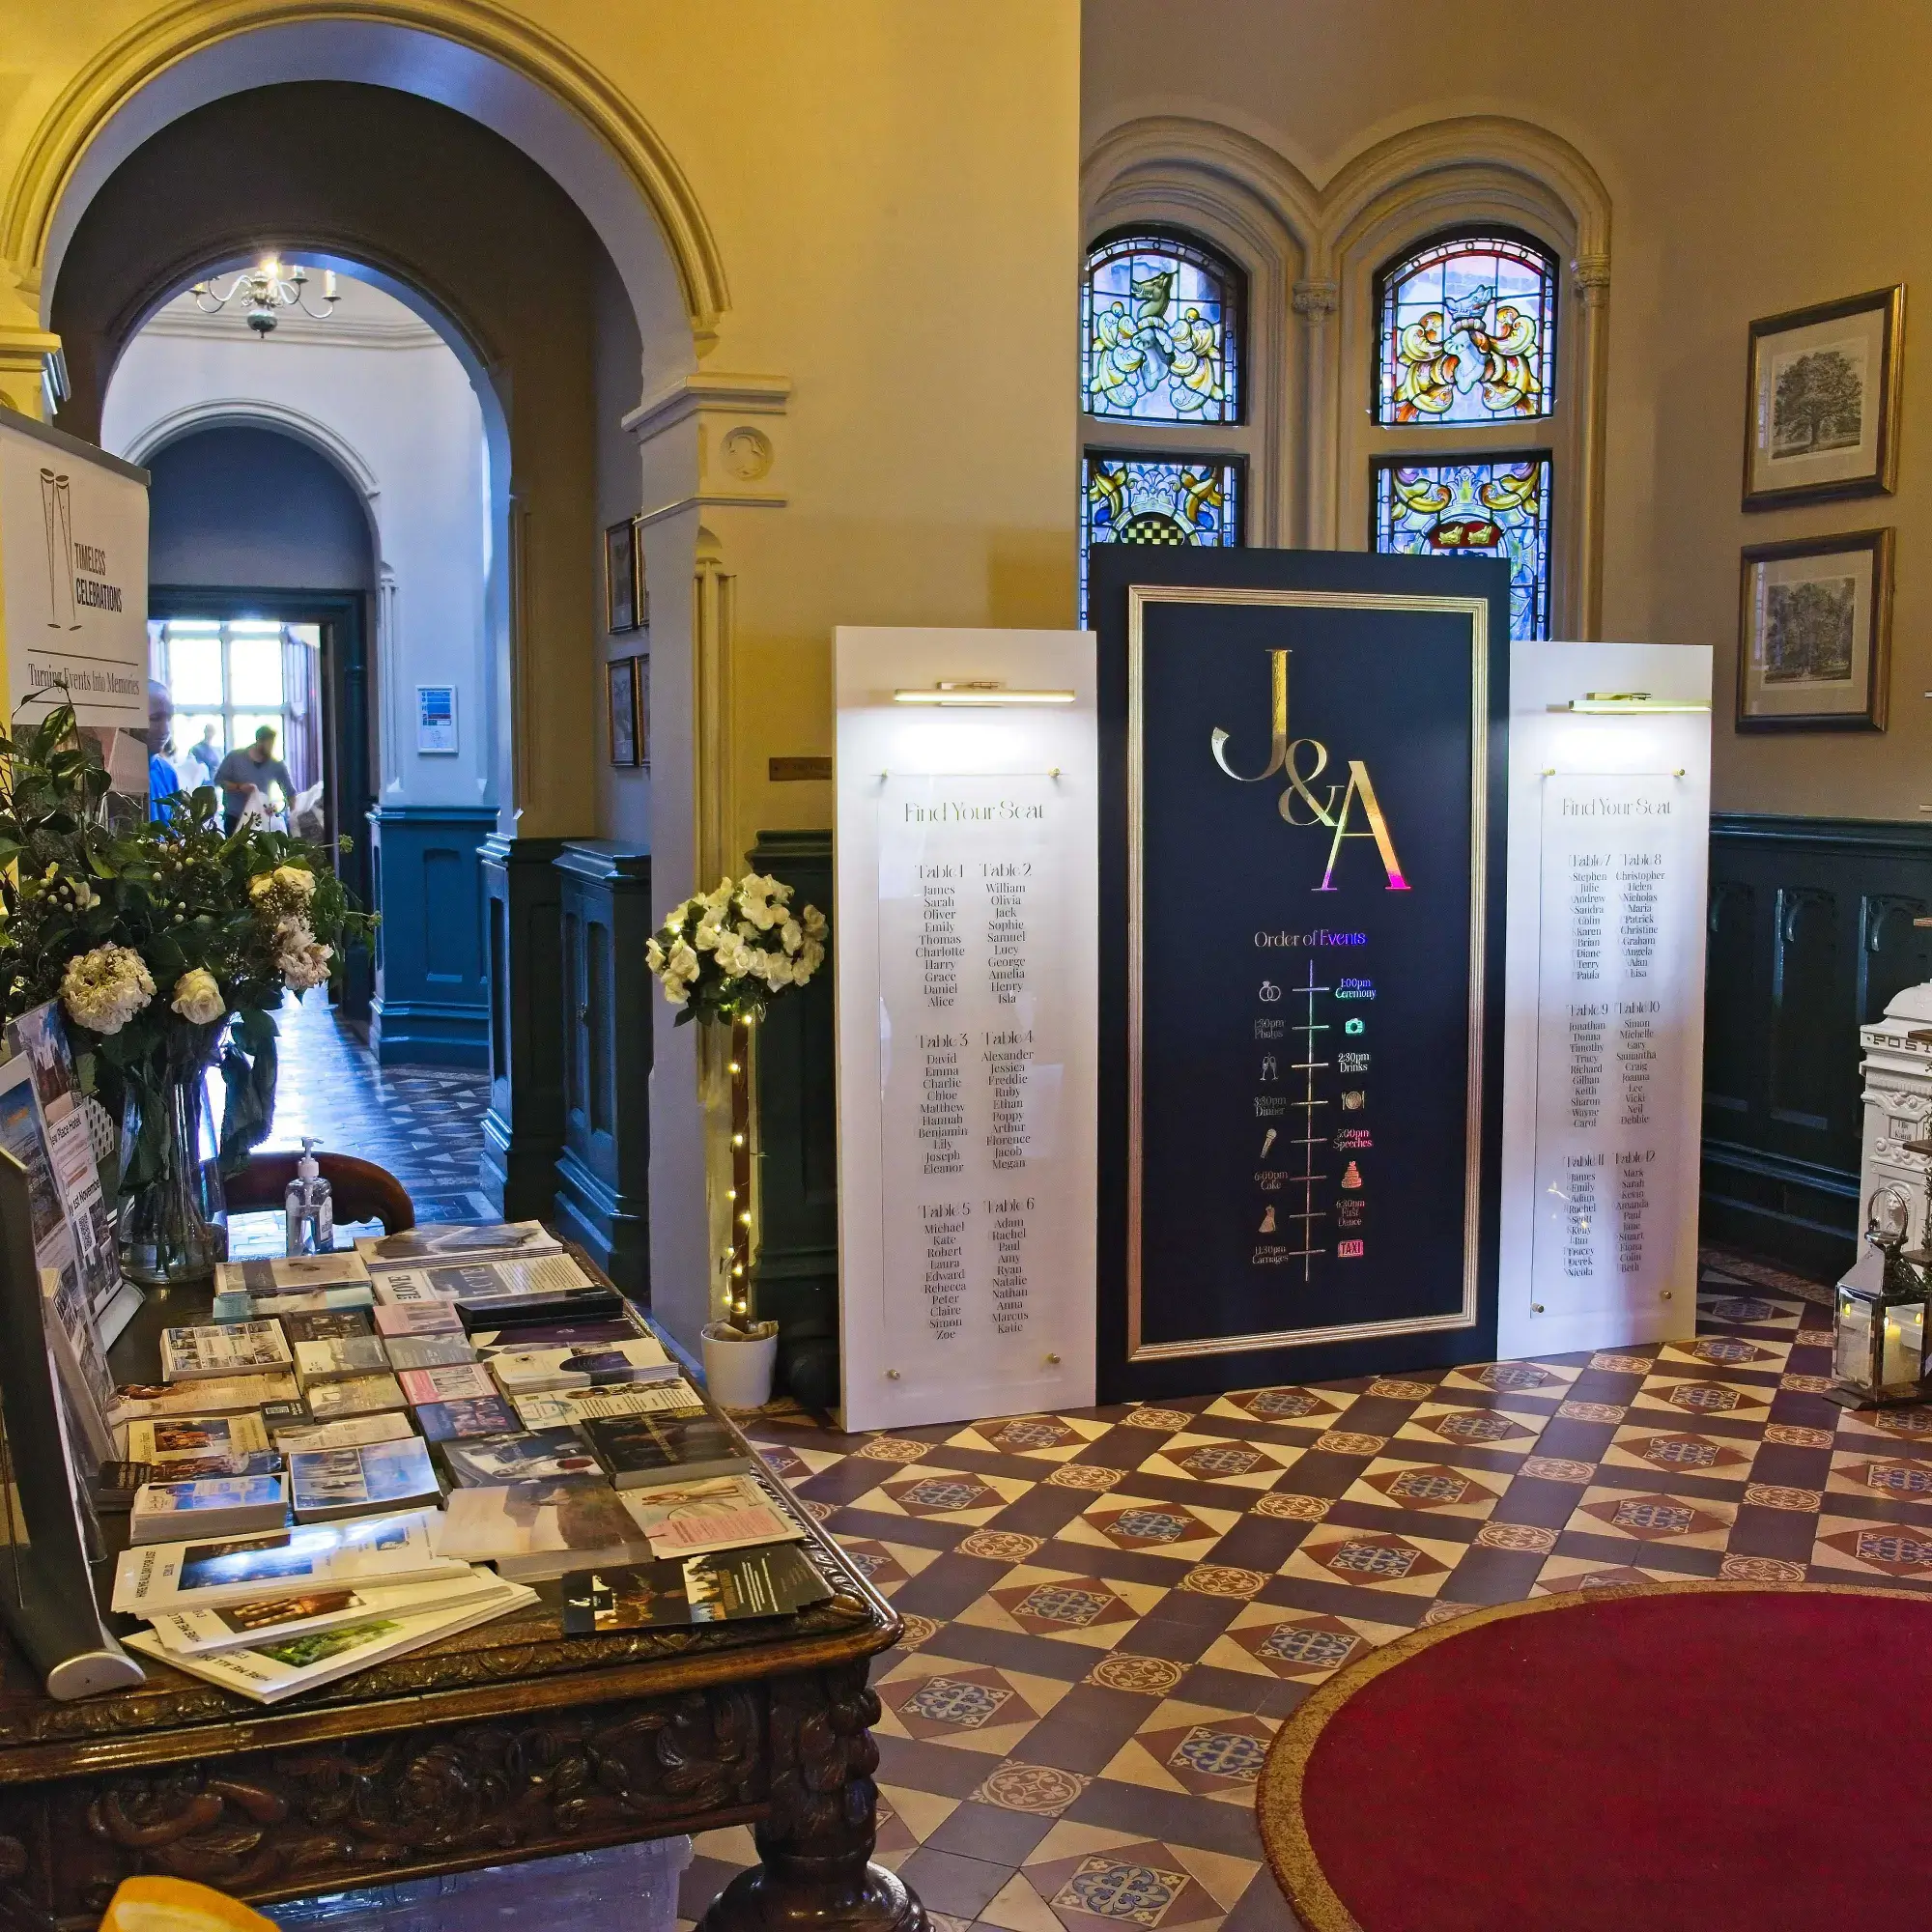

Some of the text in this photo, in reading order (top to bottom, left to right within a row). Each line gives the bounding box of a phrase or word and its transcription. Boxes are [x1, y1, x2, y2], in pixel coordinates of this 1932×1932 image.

[74, 543, 105, 576] TIMELESS
[76, 578, 122, 612] CELEBRATIONS
[28, 663, 139, 696] Turning Events Into Memories
[906, 800, 1043, 822] Find Your Seat
[1563, 797, 1671, 815] Find Your Seat
[1573, 854, 1610, 867] Table 7
[1622, 854, 1662, 866] Table 8
[915, 865, 963, 878] Table 1
[980, 863, 1032, 876] Table 2
[1573, 872, 1607, 882] Stephen
[1616, 870, 1665, 881] Christopher
[924, 885, 954, 897] James
[986, 883, 1026, 894] William
[1581, 883, 1599, 893] Julie
[1628, 882, 1652, 891] Helen
[924, 897, 954, 907] Sarah
[991, 895, 1021, 905] Olivia
[1574, 895, 1605, 903] Andrew
[1623, 893, 1658, 902] Nicholas
[923, 910, 956, 919] Oliver
[996, 908, 1016, 919] Jack
[1575, 905, 1604, 914] Sandra
[1578, 916, 1600, 924] Colin
[1626, 914, 1654, 923] Patrick
[925, 923, 954, 933] Emily
[988, 920, 1024, 931] Sophie
[1621, 925, 1658, 934] Christine
[919, 934, 961, 945] Thomas
[987, 931, 1026, 943] Samuel
[1255, 929, 1366, 947] Order of Events
[1578, 938, 1600, 947] Brian
[1623, 936, 1656, 946] Graham
[916, 947, 964, 957] Charlotte
[995, 945, 1018, 955] Lucy
[1577, 950, 1601, 958] Diane
[1626, 947, 1653, 956] Angela
[925, 960, 955, 971] Harry
[988, 957, 1025, 968] George
[1578, 960, 1599, 970] Terry
[925, 973, 956, 981] Grace
[989, 969, 1025, 980] Amelia
[1577, 970, 1599, 980] Paula
[1631, 969, 1646, 978] Lisa
[924, 984, 957, 994] Daniel
[991, 982, 1023, 992] Henry
[1341, 979, 1371, 988] 1:00pm
[999, 993, 1015, 1003] Isla
[1335, 988, 1376, 1000] Ceremony
[928, 998, 954, 1007] Alice
[1617, 1001, 1660, 1014] Table 10
[1567, 1004, 1607, 1016] Table 9
[1624, 1019, 1650, 1028] Simon
[981, 1030, 1033, 1045] Table 4
[1255, 1028, 1283, 1038] Photos
[916, 1034, 968, 1048] Table 3
[1570, 1042, 1604, 1053] Timothy
[927, 1053, 956, 1065] David
[981, 1049, 1034, 1062] Alexander
[1338, 1053, 1370, 1064] 2:30pm
[925, 1067, 958, 1076] Emma
[991, 1064, 1025, 1075] Jessica
[1340, 1062, 1368, 1072] Drinks
[1571, 1065, 1602, 1074] Richard
[1625, 1062, 1647, 1071] Craig
[923, 1078, 962, 1089] Charlie
[988, 1075, 1028, 1085] Freddie
[927, 1091, 957, 1101] Chloe
[995, 1087, 1020, 1097] Ruby
[1572, 1097, 1600, 1106] Sharon
[1626, 1094, 1645, 1102] Vicki
[920, 1103, 964, 1114] Matthew
[994, 1099, 1023, 1109] Ethan
[1256, 1106, 1285, 1117] Dinner
[923, 1114, 963, 1125] Hannah
[993, 1112, 1024, 1123] Poppy
[57, 1114, 81, 1138] Place Hotel
[993, 1123, 1025, 1133] Arthur
[919, 1126, 968, 1138] Benjamin
[934, 1139, 952, 1151] Lily
[986, 1135, 1031, 1146] Florence
[1333, 1139, 1373, 1151] Speeches
[926, 1151, 960, 1163] Joseph
[995, 1147, 1022, 1158] Jacob
[923, 1164, 964, 1174] Eleanor
[993, 1159, 1025, 1170] Megan
[1255, 1171, 1288, 1181] 6:00pm
[1261, 1179, 1281, 1190] Cake
[919, 1203, 970, 1218] Table 5
[983, 1197, 1035, 1213] Table 6
[1342, 1208, 1359, 1217] First
[995, 1217, 1024, 1228] Adam
[1339, 1217, 1361, 1227] Dance
[924, 1222, 964, 1235] Michael
[992, 1229, 1026, 1240] Rachel
[933, 1236, 956, 1245] Kate
[999, 1240, 1020, 1251] Paul
[927, 1246, 962, 1258] Robert
[1341, 1241, 1361, 1255] TAXI
[930, 1260, 959, 1269] Laura
[998, 1254, 1020, 1264] Amy
[1252, 1254, 1289, 1264] Carriages
[925, 1269, 965, 1282] Edward
[998, 1265, 1021, 1276] Ryan
[388, 1275, 420, 1295] LOVE
[993, 1276, 1027, 1288] Natalie
[924, 1283, 966, 1293] Rebecca
[932, 1295, 959, 1304] Peter
[993, 1289, 1028, 1299] Nathan
[997, 1301, 1023, 1310] Anna
[930, 1306, 961, 1317] Claire
[993, 1313, 1029, 1322] Marcus
[929, 1319, 962, 1328] Simon
[998, 1323, 1023, 1334] Katie
[937, 1330, 955, 1340] Zoe
